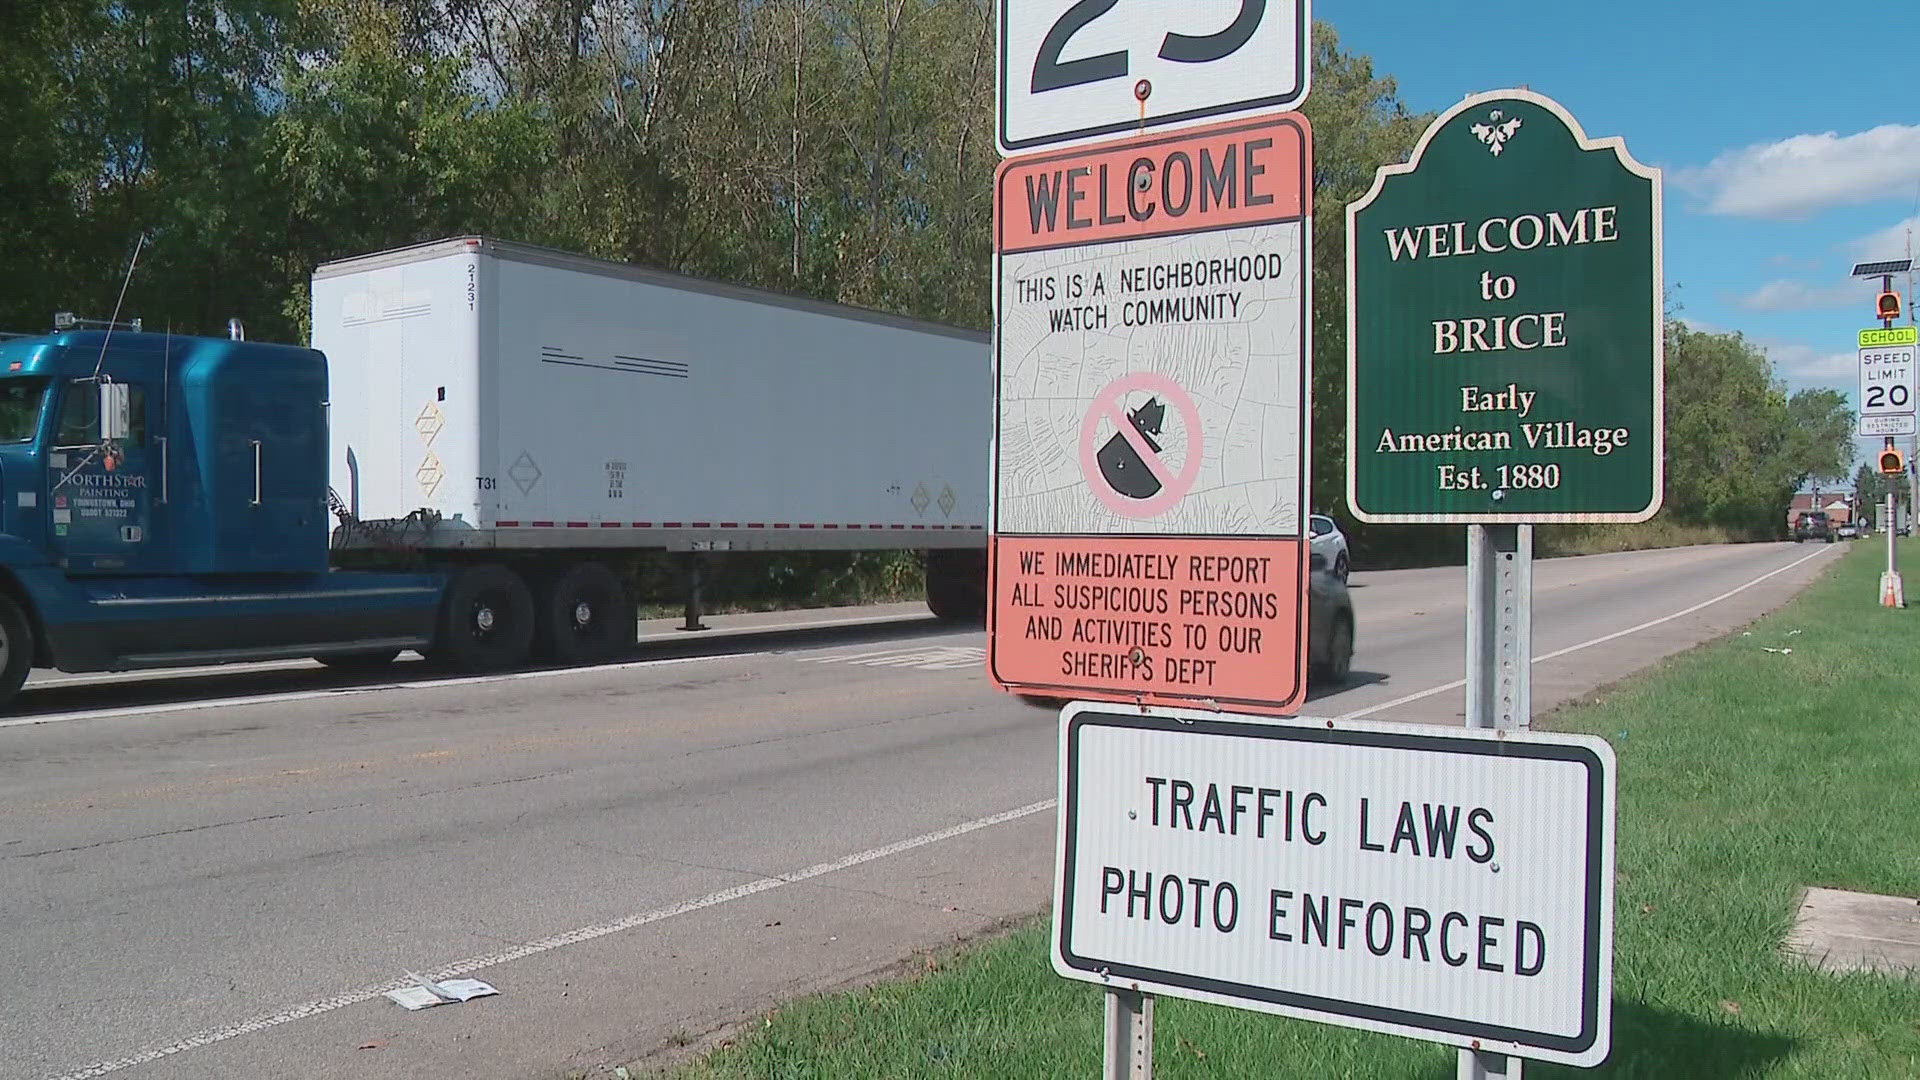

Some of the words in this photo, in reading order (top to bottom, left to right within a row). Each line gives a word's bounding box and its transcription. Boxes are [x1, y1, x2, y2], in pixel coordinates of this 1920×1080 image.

[1025, 138, 1274, 235] WELCOME
[1384, 206, 1619, 261] WELCOME
[467, 264, 475, 311] 21231
[1017, 277, 1055, 303] THIS
[1066, 274, 1083, 299] IS
[1093, 273, 1105, 296] A
[1120, 253, 1282, 294] NEIGHBORHOOD
[1480, 271, 1516, 300] to
[1049, 304, 1108, 333] WATCH
[1123, 292, 1242, 327] COMMUNITY
[1432, 312, 1567, 354] BRICE
[1862, 330, 1912, 343] SCHOOL
[1864, 352, 1911, 365] SPEED
[1868, 369, 1906, 380] LIMIT
[1461, 383, 1536, 417] Early
[1867, 384, 1908, 407] 20
[1376, 426, 1511, 453] American
[1520, 421, 1629, 455] Village
[80, 488, 129, 497] PAINTING
[476, 477, 496, 490] T31
[1437, 465, 1488, 490] Est.
[1496, 464, 1560, 489] 1880
[1019, 551, 1045, 575] WE
[1055, 552, 1178, 580] IMMEDIATELY
[1189, 555, 1271, 584] REPORT
[1011, 582, 1044, 607] ALL
[1054, 584, 1168, 614] SUSPICIOUS
[1180, 589, 1277, 620] PERSONS
[1025, 615, 1062, 641] AND
[1072, 618, 1172, 648] ACTIVITIES
[1183, 624, 1207, 650] TO
[1219, 626, 1262, 654] OUR
[1165, 658, 1217, 686] DEPT
[1145, 776, 1327, 845] TRAFFIC
[1360, 797, 1495, 864] LAWS
[1101, 866, 1238, 933] PHOTO
[1269, 889, 1546, 977] ENFORCED
